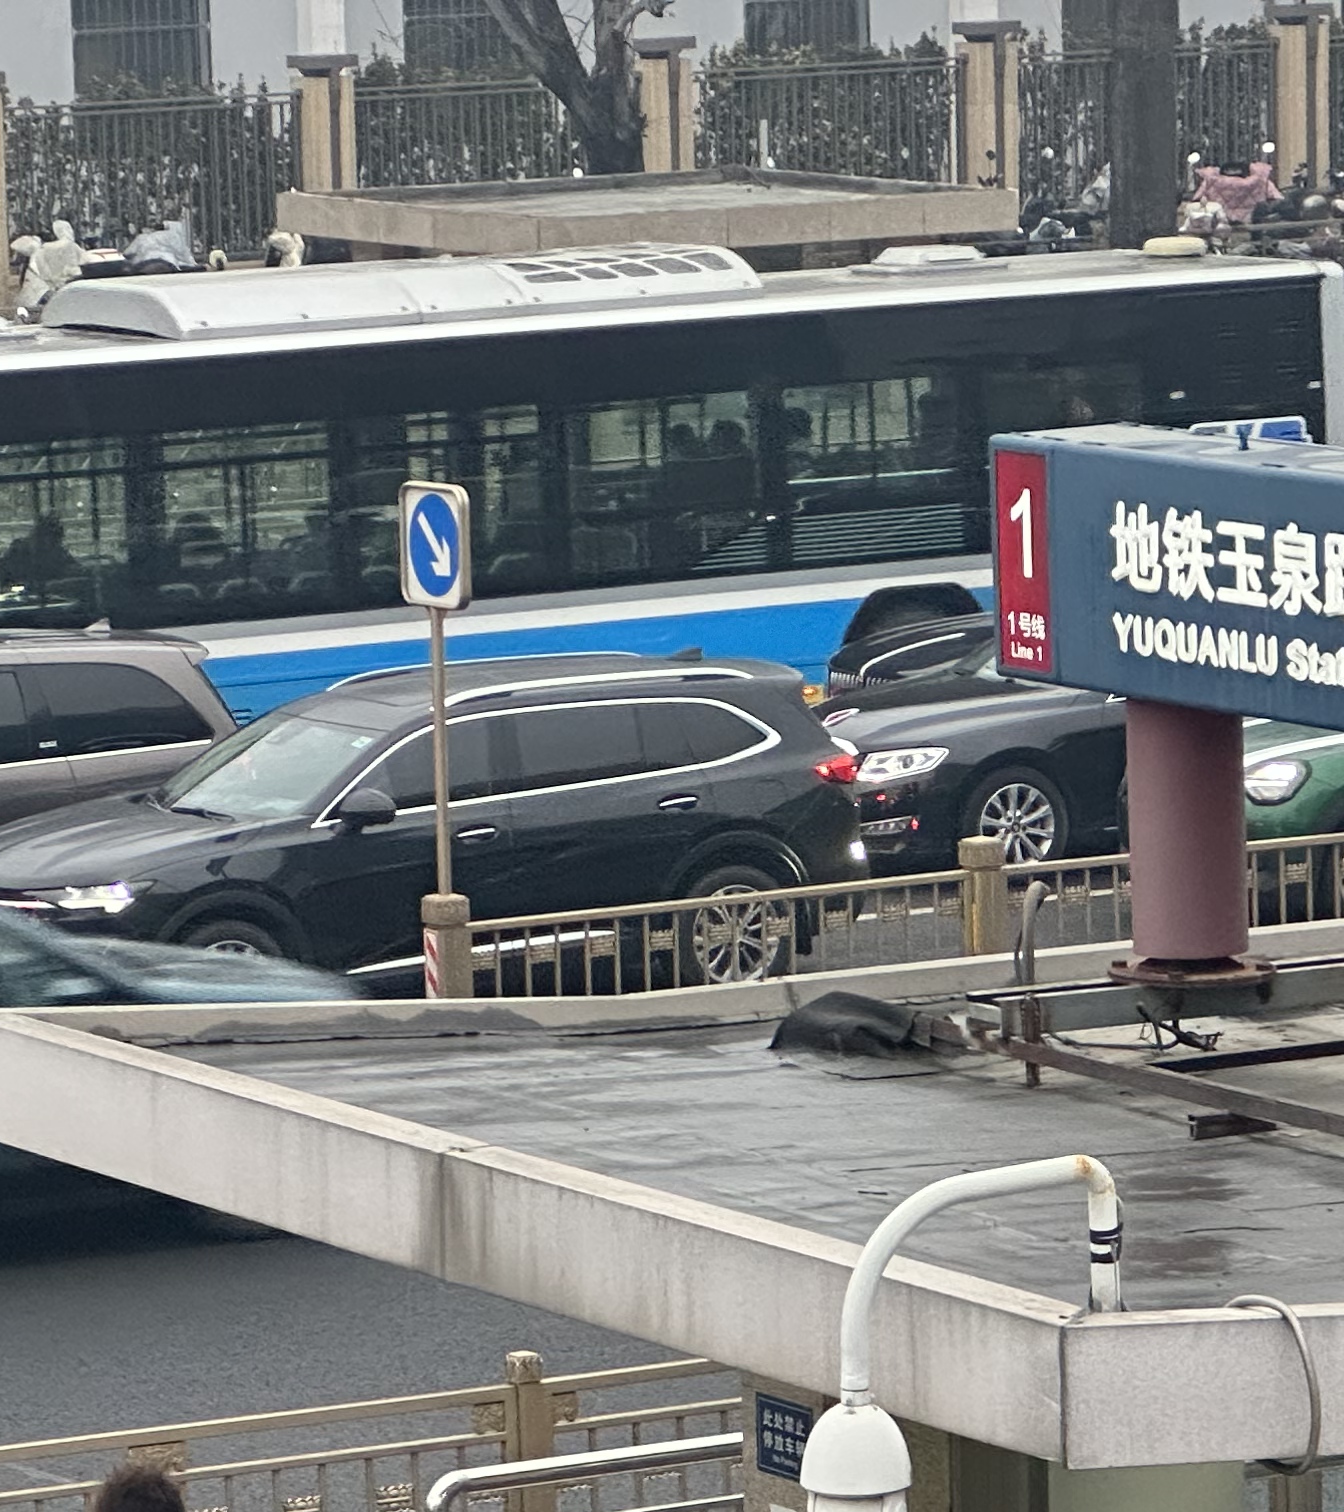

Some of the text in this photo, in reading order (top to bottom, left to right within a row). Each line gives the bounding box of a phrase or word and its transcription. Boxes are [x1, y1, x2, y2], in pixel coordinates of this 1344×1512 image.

[1010, 487, 1033, 579] 1
[1007, 611, 1046, 640] 1号线
[1011, 641, 1043, 662] Line 1
[1112, 611, 1279, 677] YUQUANLU
[763, 1408, 806, 1437] 此处禁止
